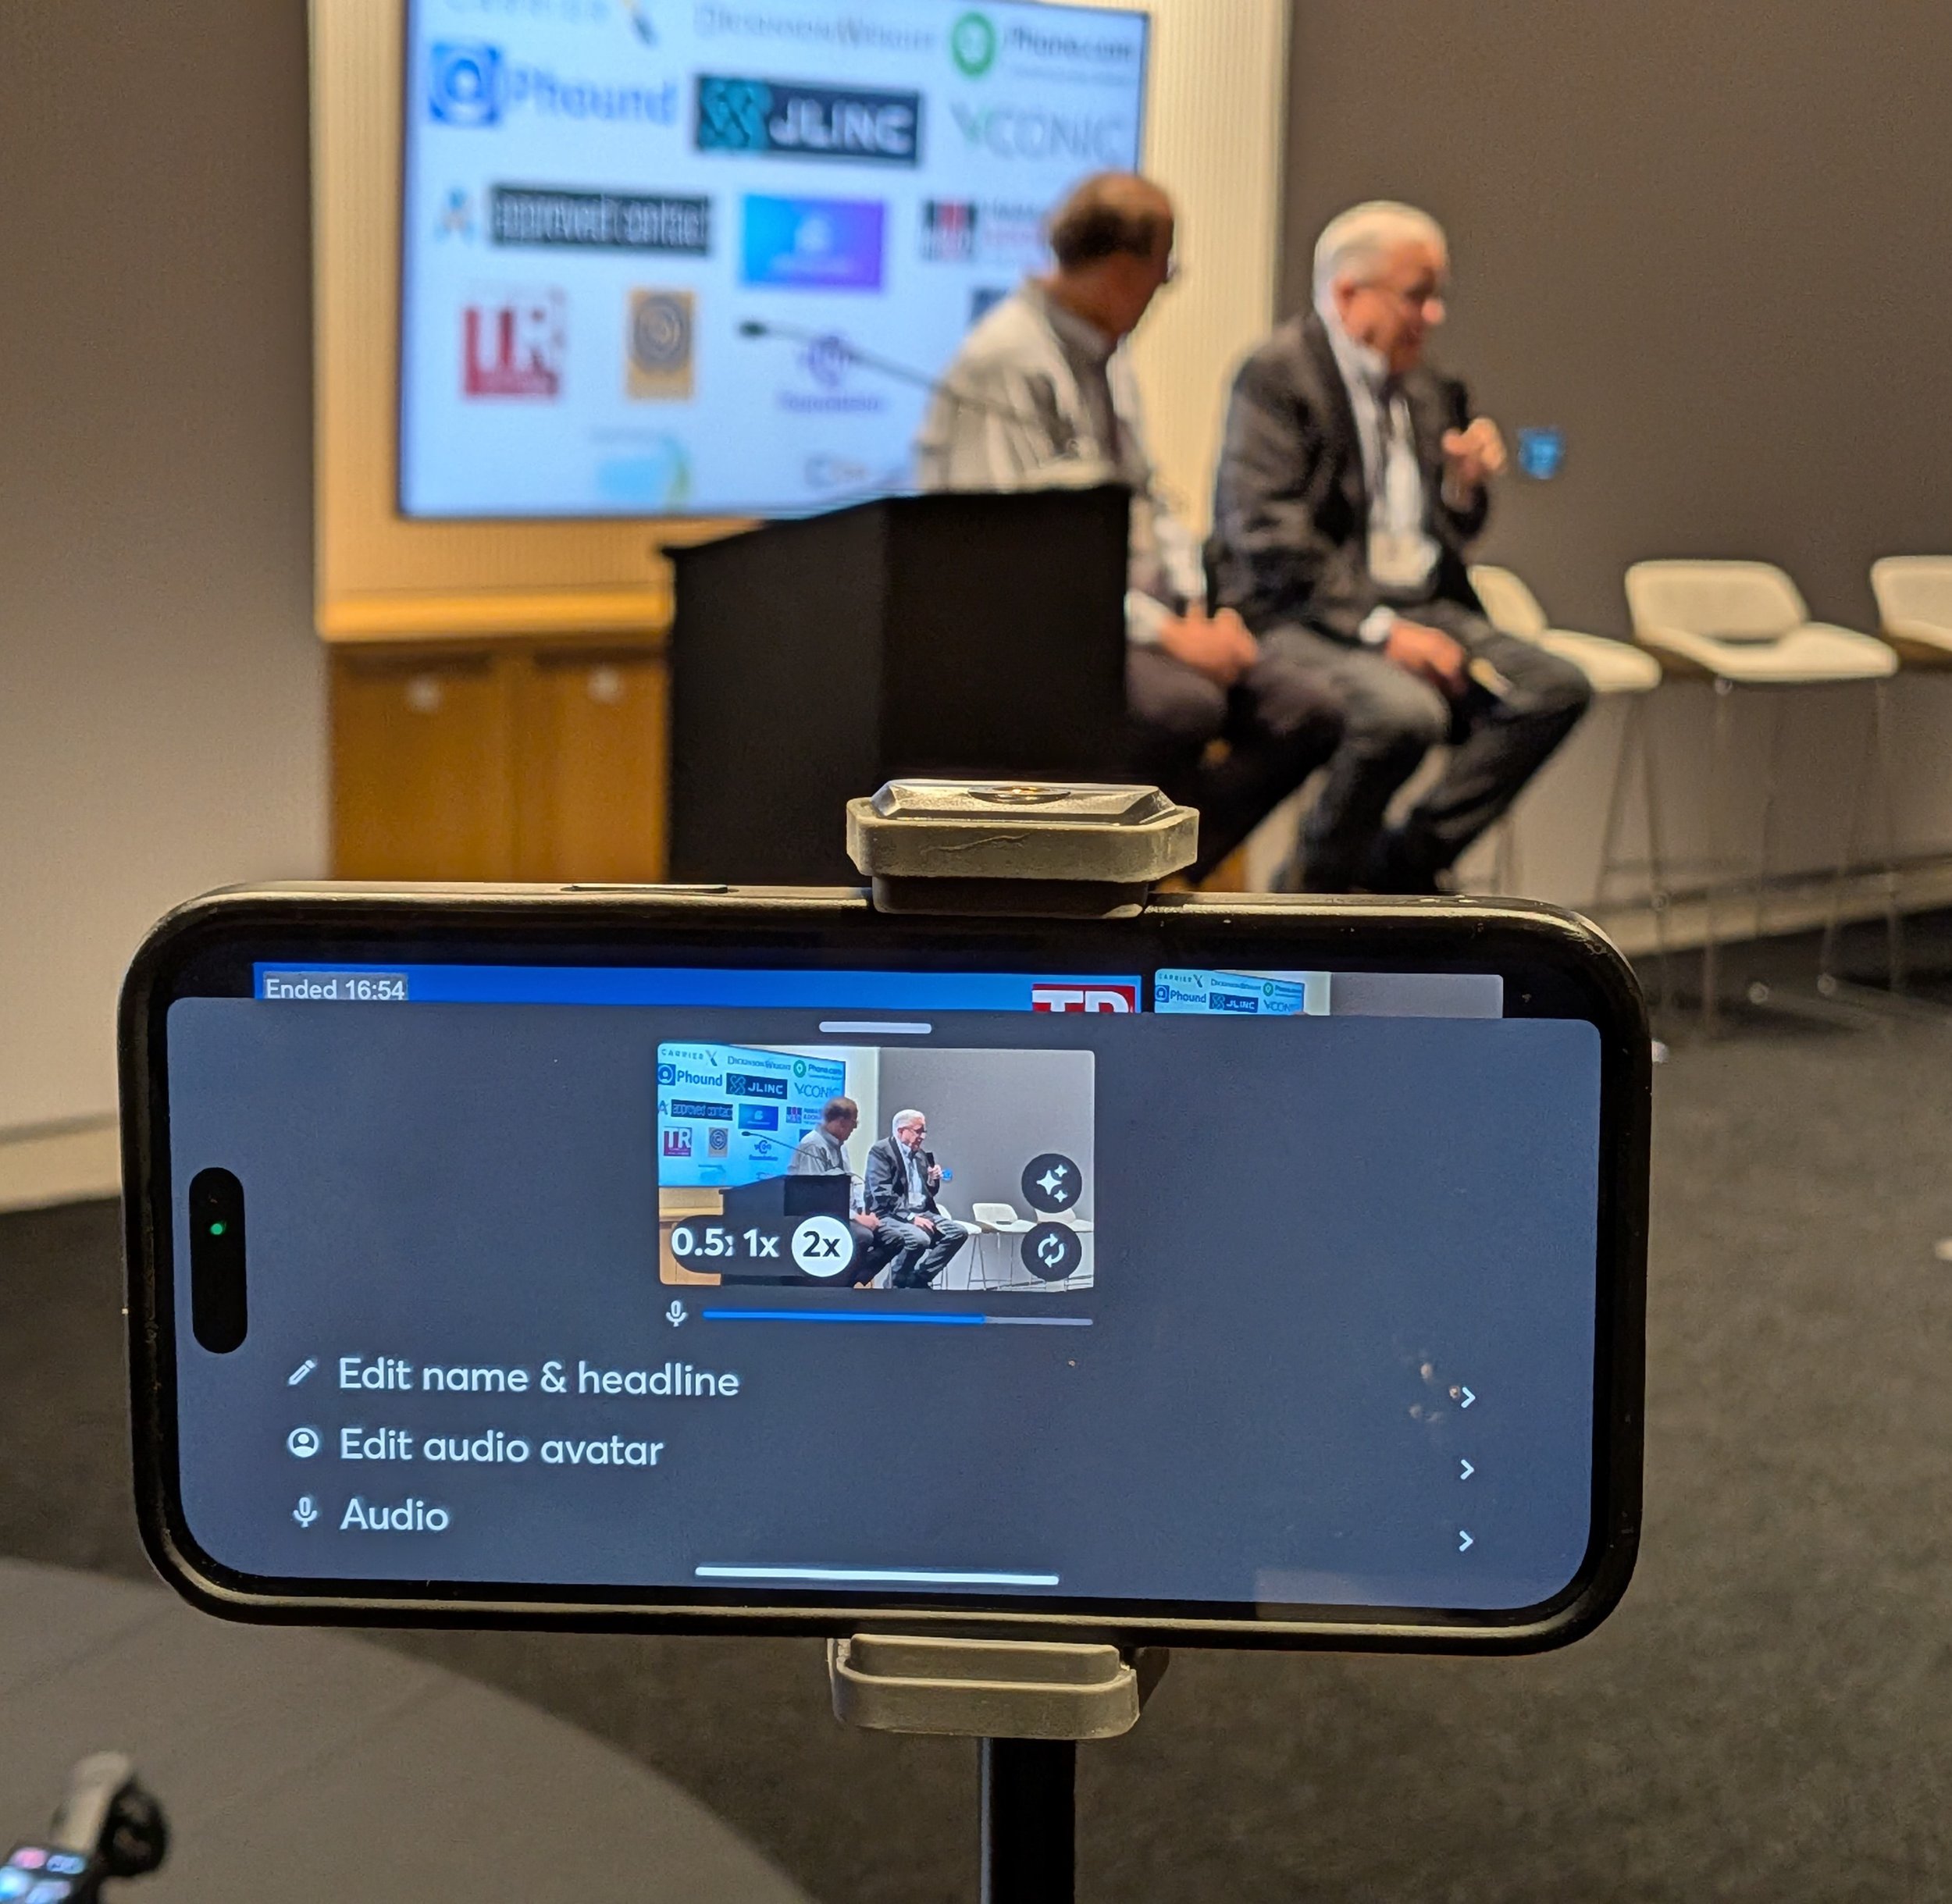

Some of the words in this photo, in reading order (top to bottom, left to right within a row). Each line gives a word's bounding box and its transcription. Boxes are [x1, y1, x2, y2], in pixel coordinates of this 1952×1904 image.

[508, 64, 678, 125] Phound
[769, 95, 915, 154] JLINC
[265, 979, 337, 999] Ended
[345, 980, 404, 1000] 16:54
[1170, 990, 1207, 1004] Phound
[677, 1069, 723, 1087] Phound
[748, 1082, 783, 1095] JLINC
[743, 1229, 780, 1258] 1x
[803, 1231, 841, 1258] 2x
[339, 1357, 411, 1390] Edit
[422, 1367, 529, 1393] name
[540, 1361, 568, 1393] &
[578, 1361, 739, 1396] headline
[340, 1427, 412, 1460] Edit
[423, 1430, 529, 1463] audio
[540, 1435, 664, 1466] avatar
[339, 1497, 450, 1532] Audio
